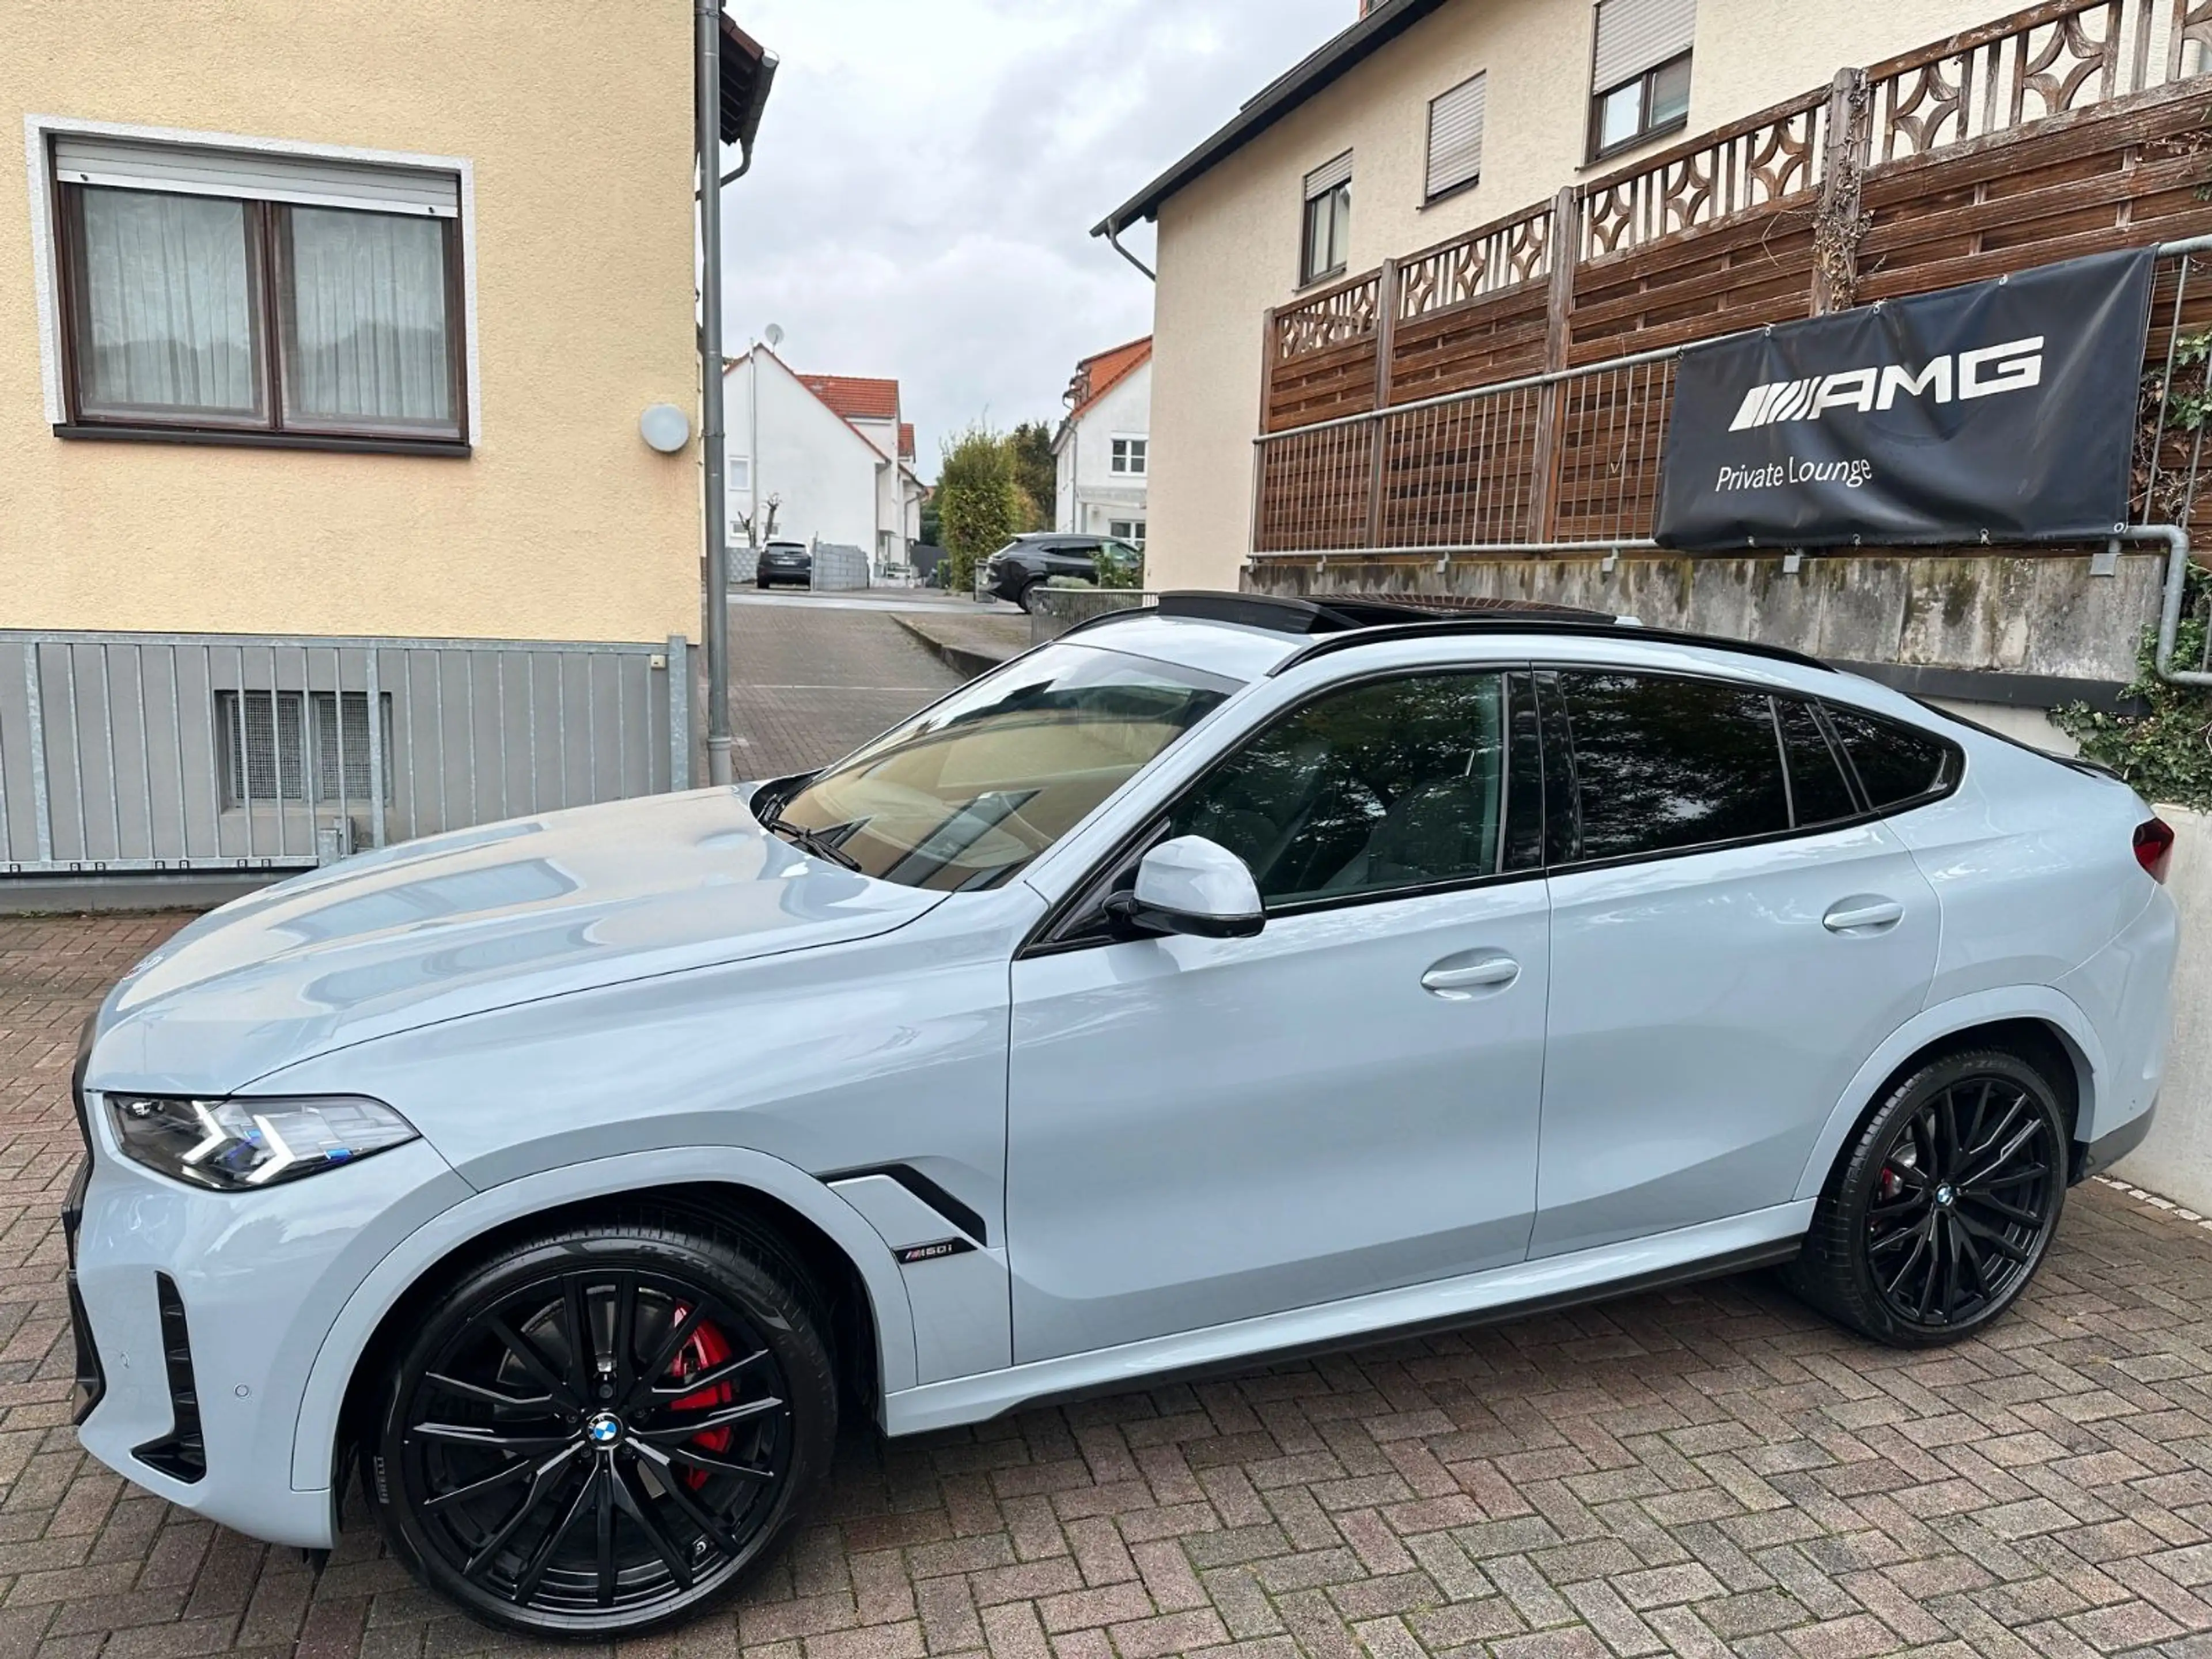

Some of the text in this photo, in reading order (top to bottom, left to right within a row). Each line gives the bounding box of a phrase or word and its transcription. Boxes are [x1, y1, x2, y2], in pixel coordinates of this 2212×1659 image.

[1807, 335, 2044, 419] AMG
[1715, 455, 1873, 493] Private Lounge
